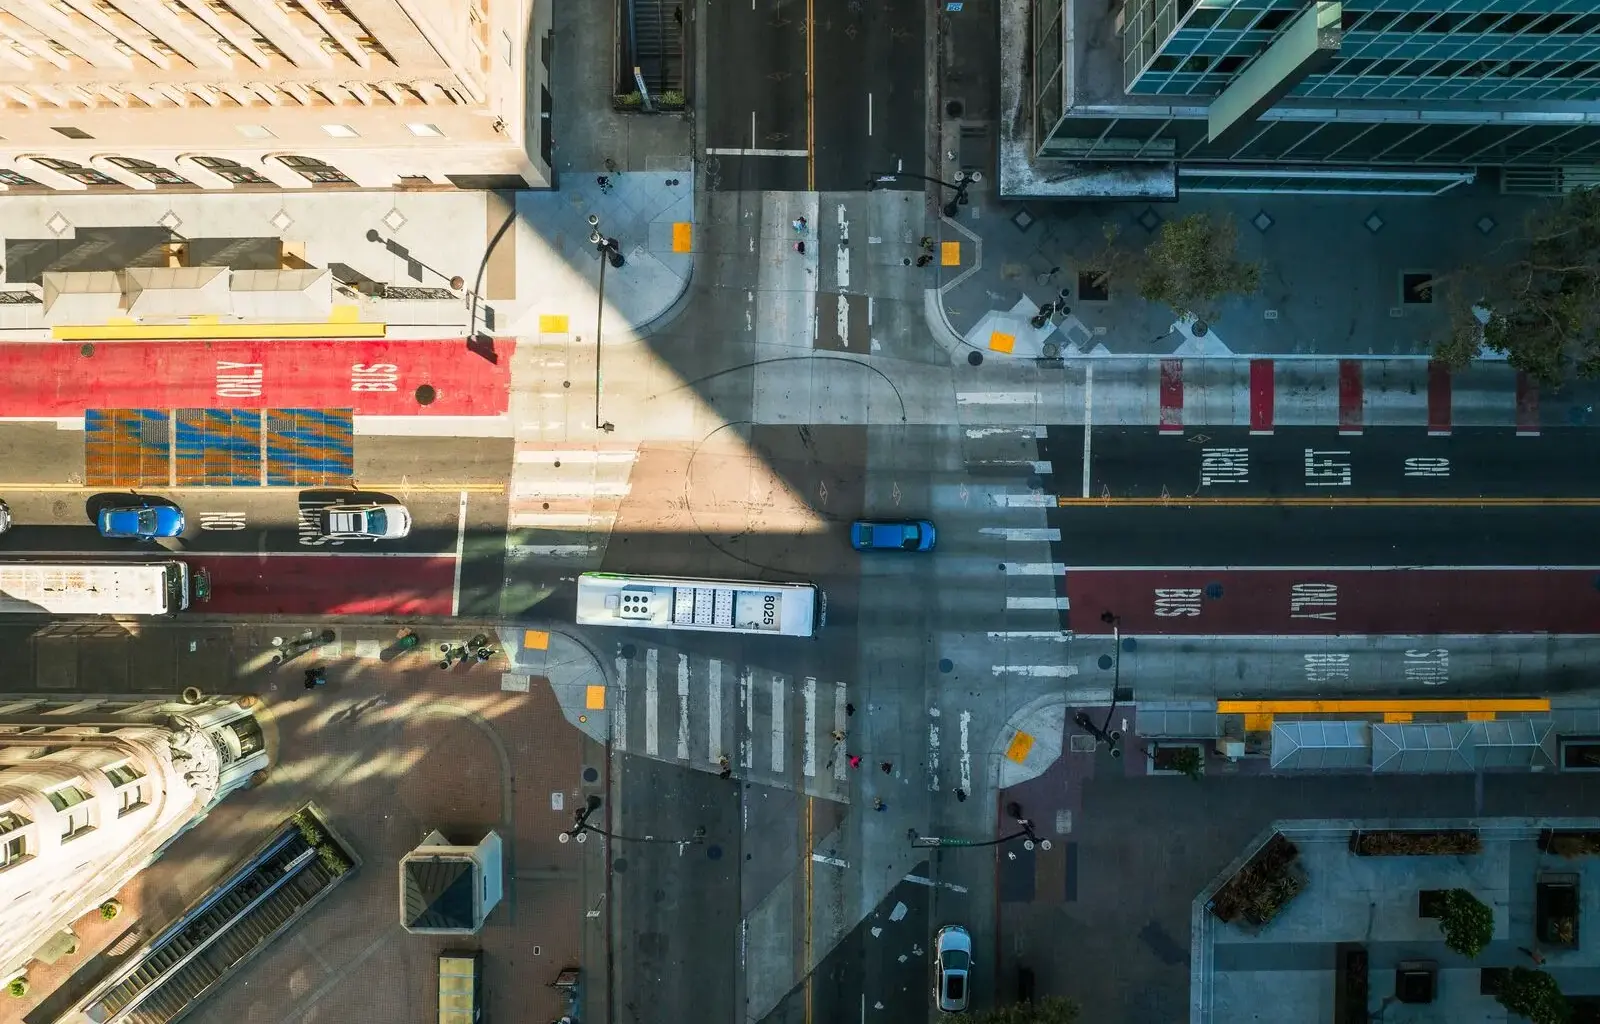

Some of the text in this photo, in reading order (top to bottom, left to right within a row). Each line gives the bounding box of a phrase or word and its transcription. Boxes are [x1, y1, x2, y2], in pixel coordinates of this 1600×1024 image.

[216, 361, 263, 398] ONLY
[351, 364, 398, 392] BUS
[1202, 448, 1249, 486] TURN
[1304, 448, 1352, 486] LEFT
[1405, 457, 1450, 477] NO
[200, 511, 246, 530] NO
[763, 595, 775, 625] 8025
[1154, 588, 1202, 617] BUS
[1290, 583, 1338, 621] ONLY
[1404, 648, 1449, 685] STOP
